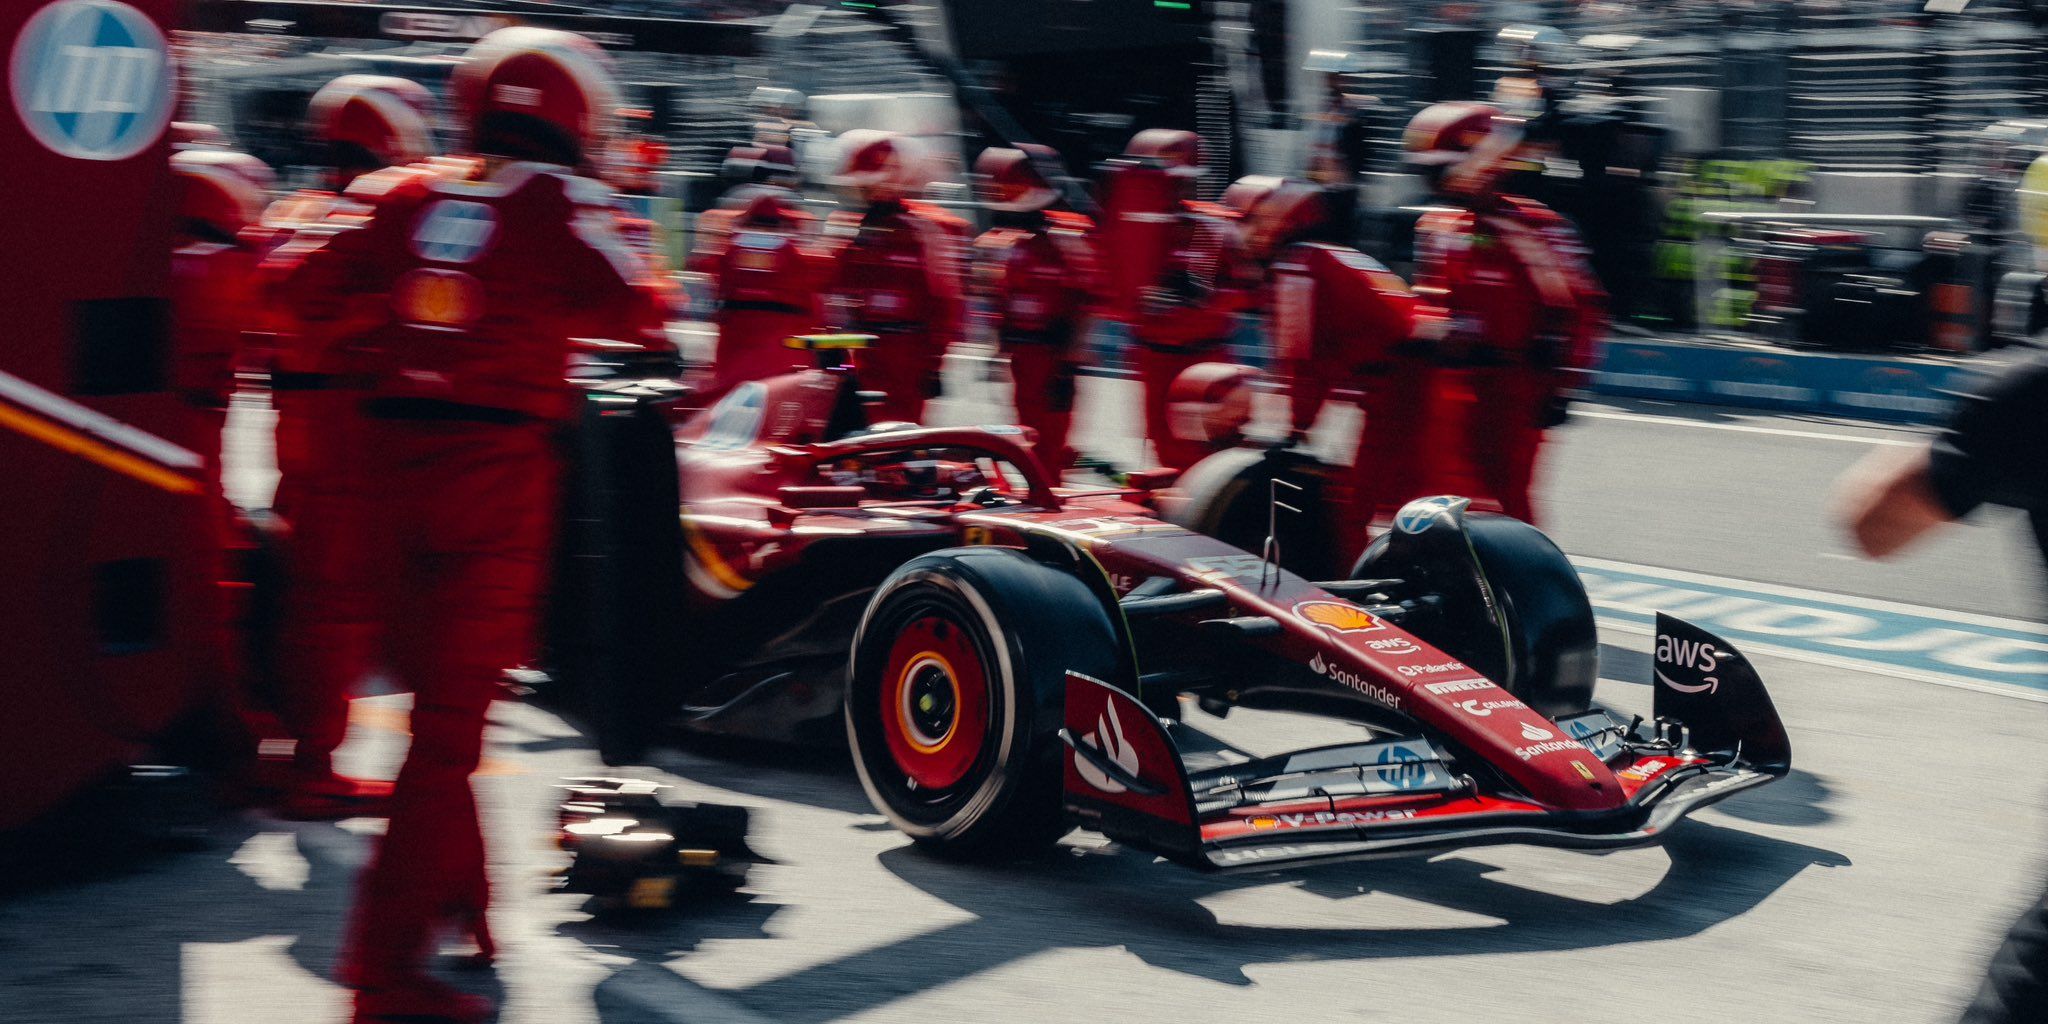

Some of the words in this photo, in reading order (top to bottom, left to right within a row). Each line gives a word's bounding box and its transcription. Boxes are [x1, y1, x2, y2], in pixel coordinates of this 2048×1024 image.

[1656, 634, 1717, 673] aws
[1328, 663, 1401, 709] Santander
[1379, 743, 1424, 789] hp
[1279, 808, 1417, 828] V-Power
